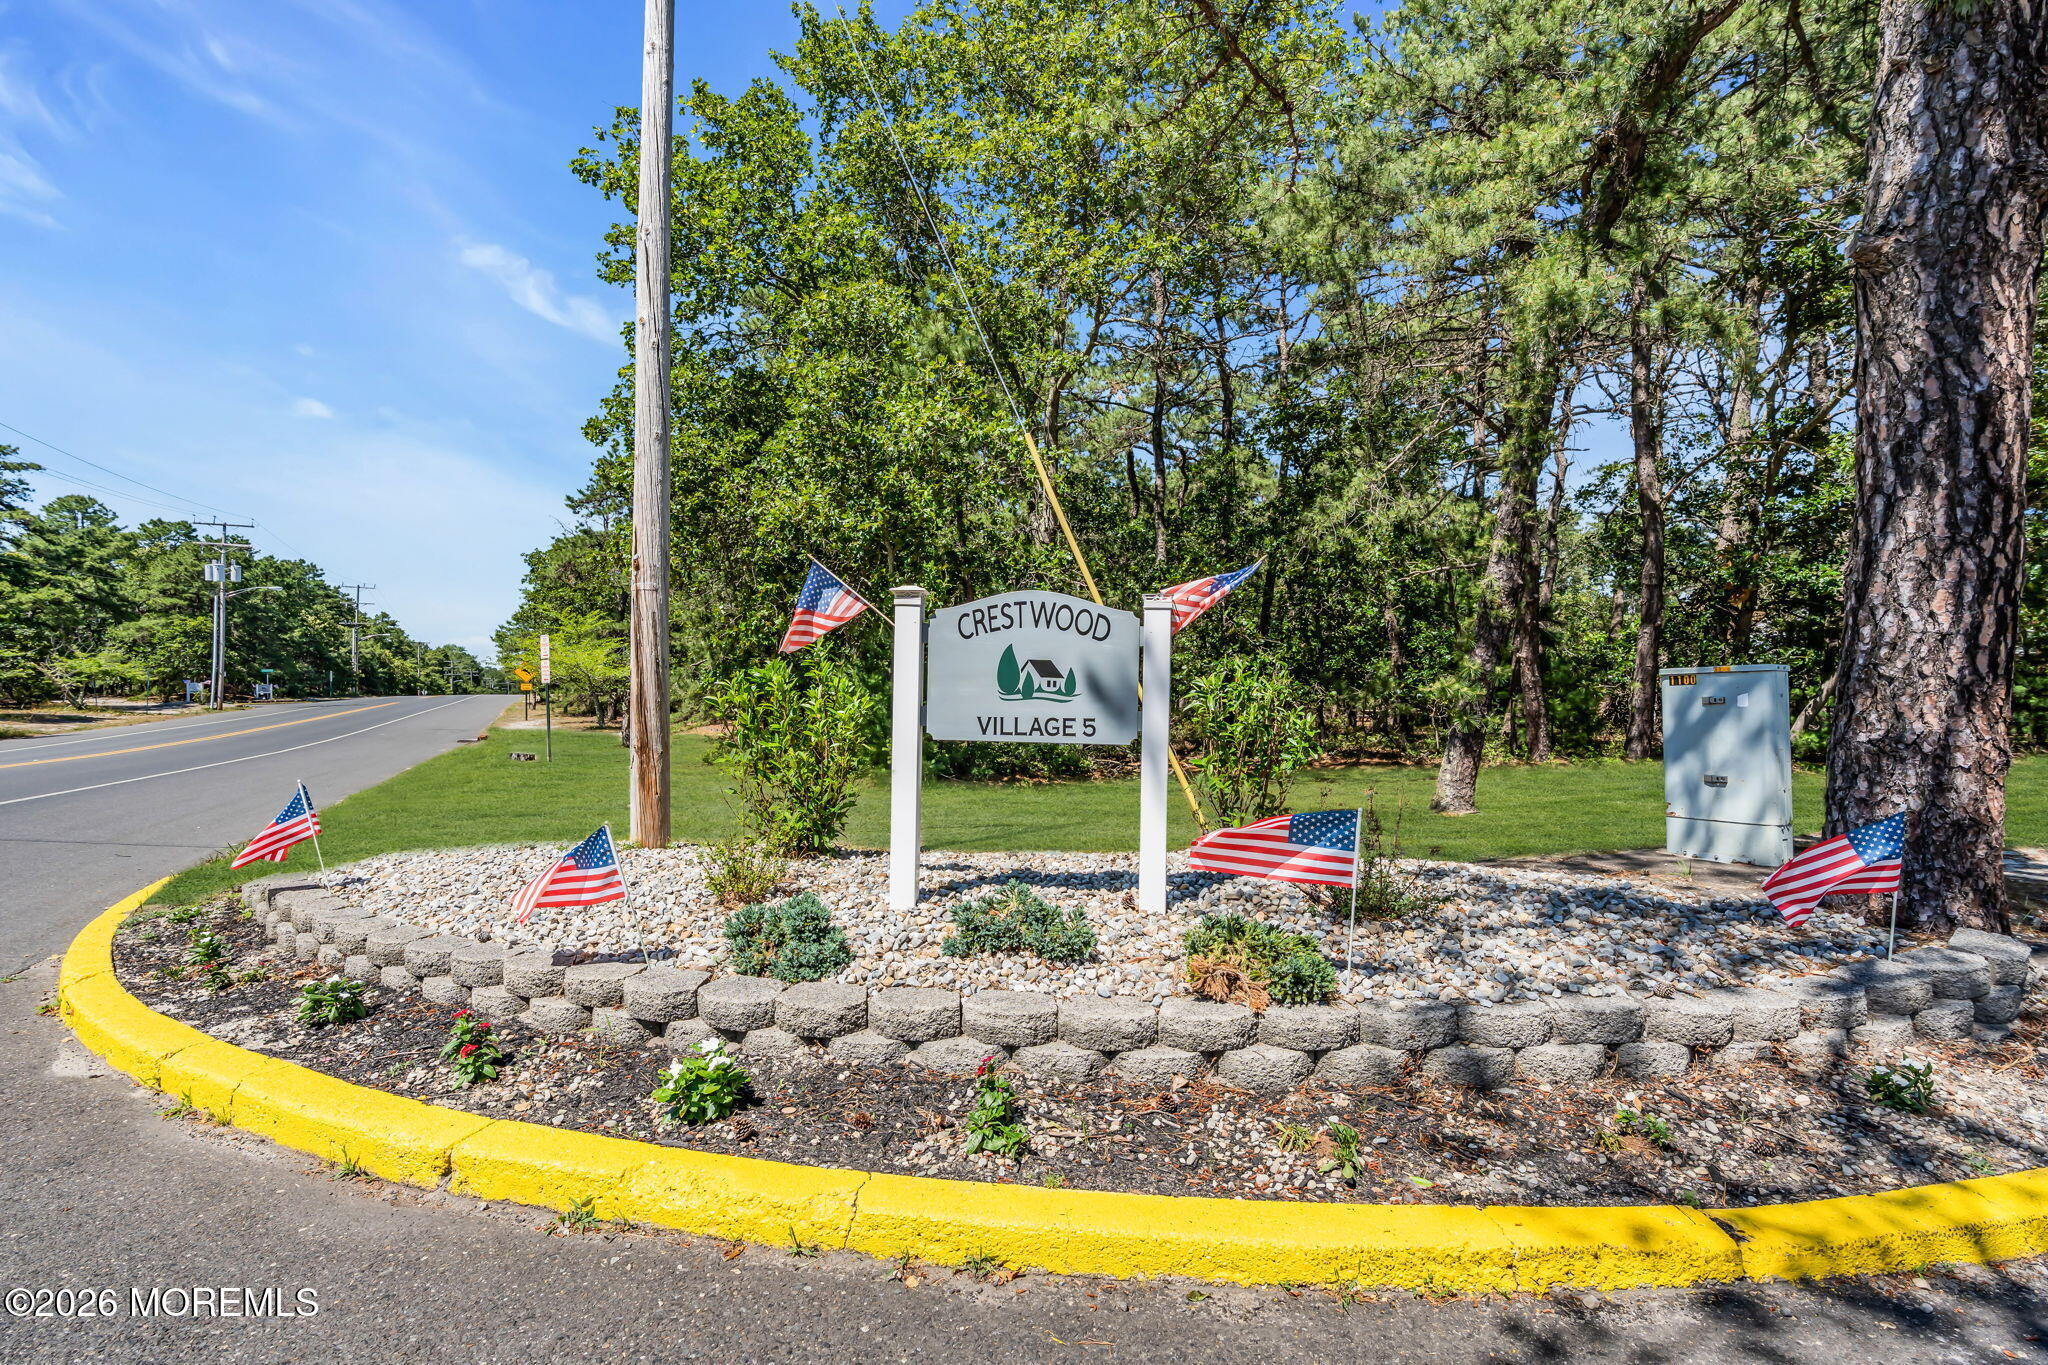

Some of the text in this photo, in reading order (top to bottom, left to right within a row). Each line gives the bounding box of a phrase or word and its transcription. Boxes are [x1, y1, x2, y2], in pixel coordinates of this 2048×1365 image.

[957, 600, 1111, 642] CRESTWOOD
[1670, 674, 1696, 686] 1100
[976, 716, 1097, 737] VILLAGE 5
